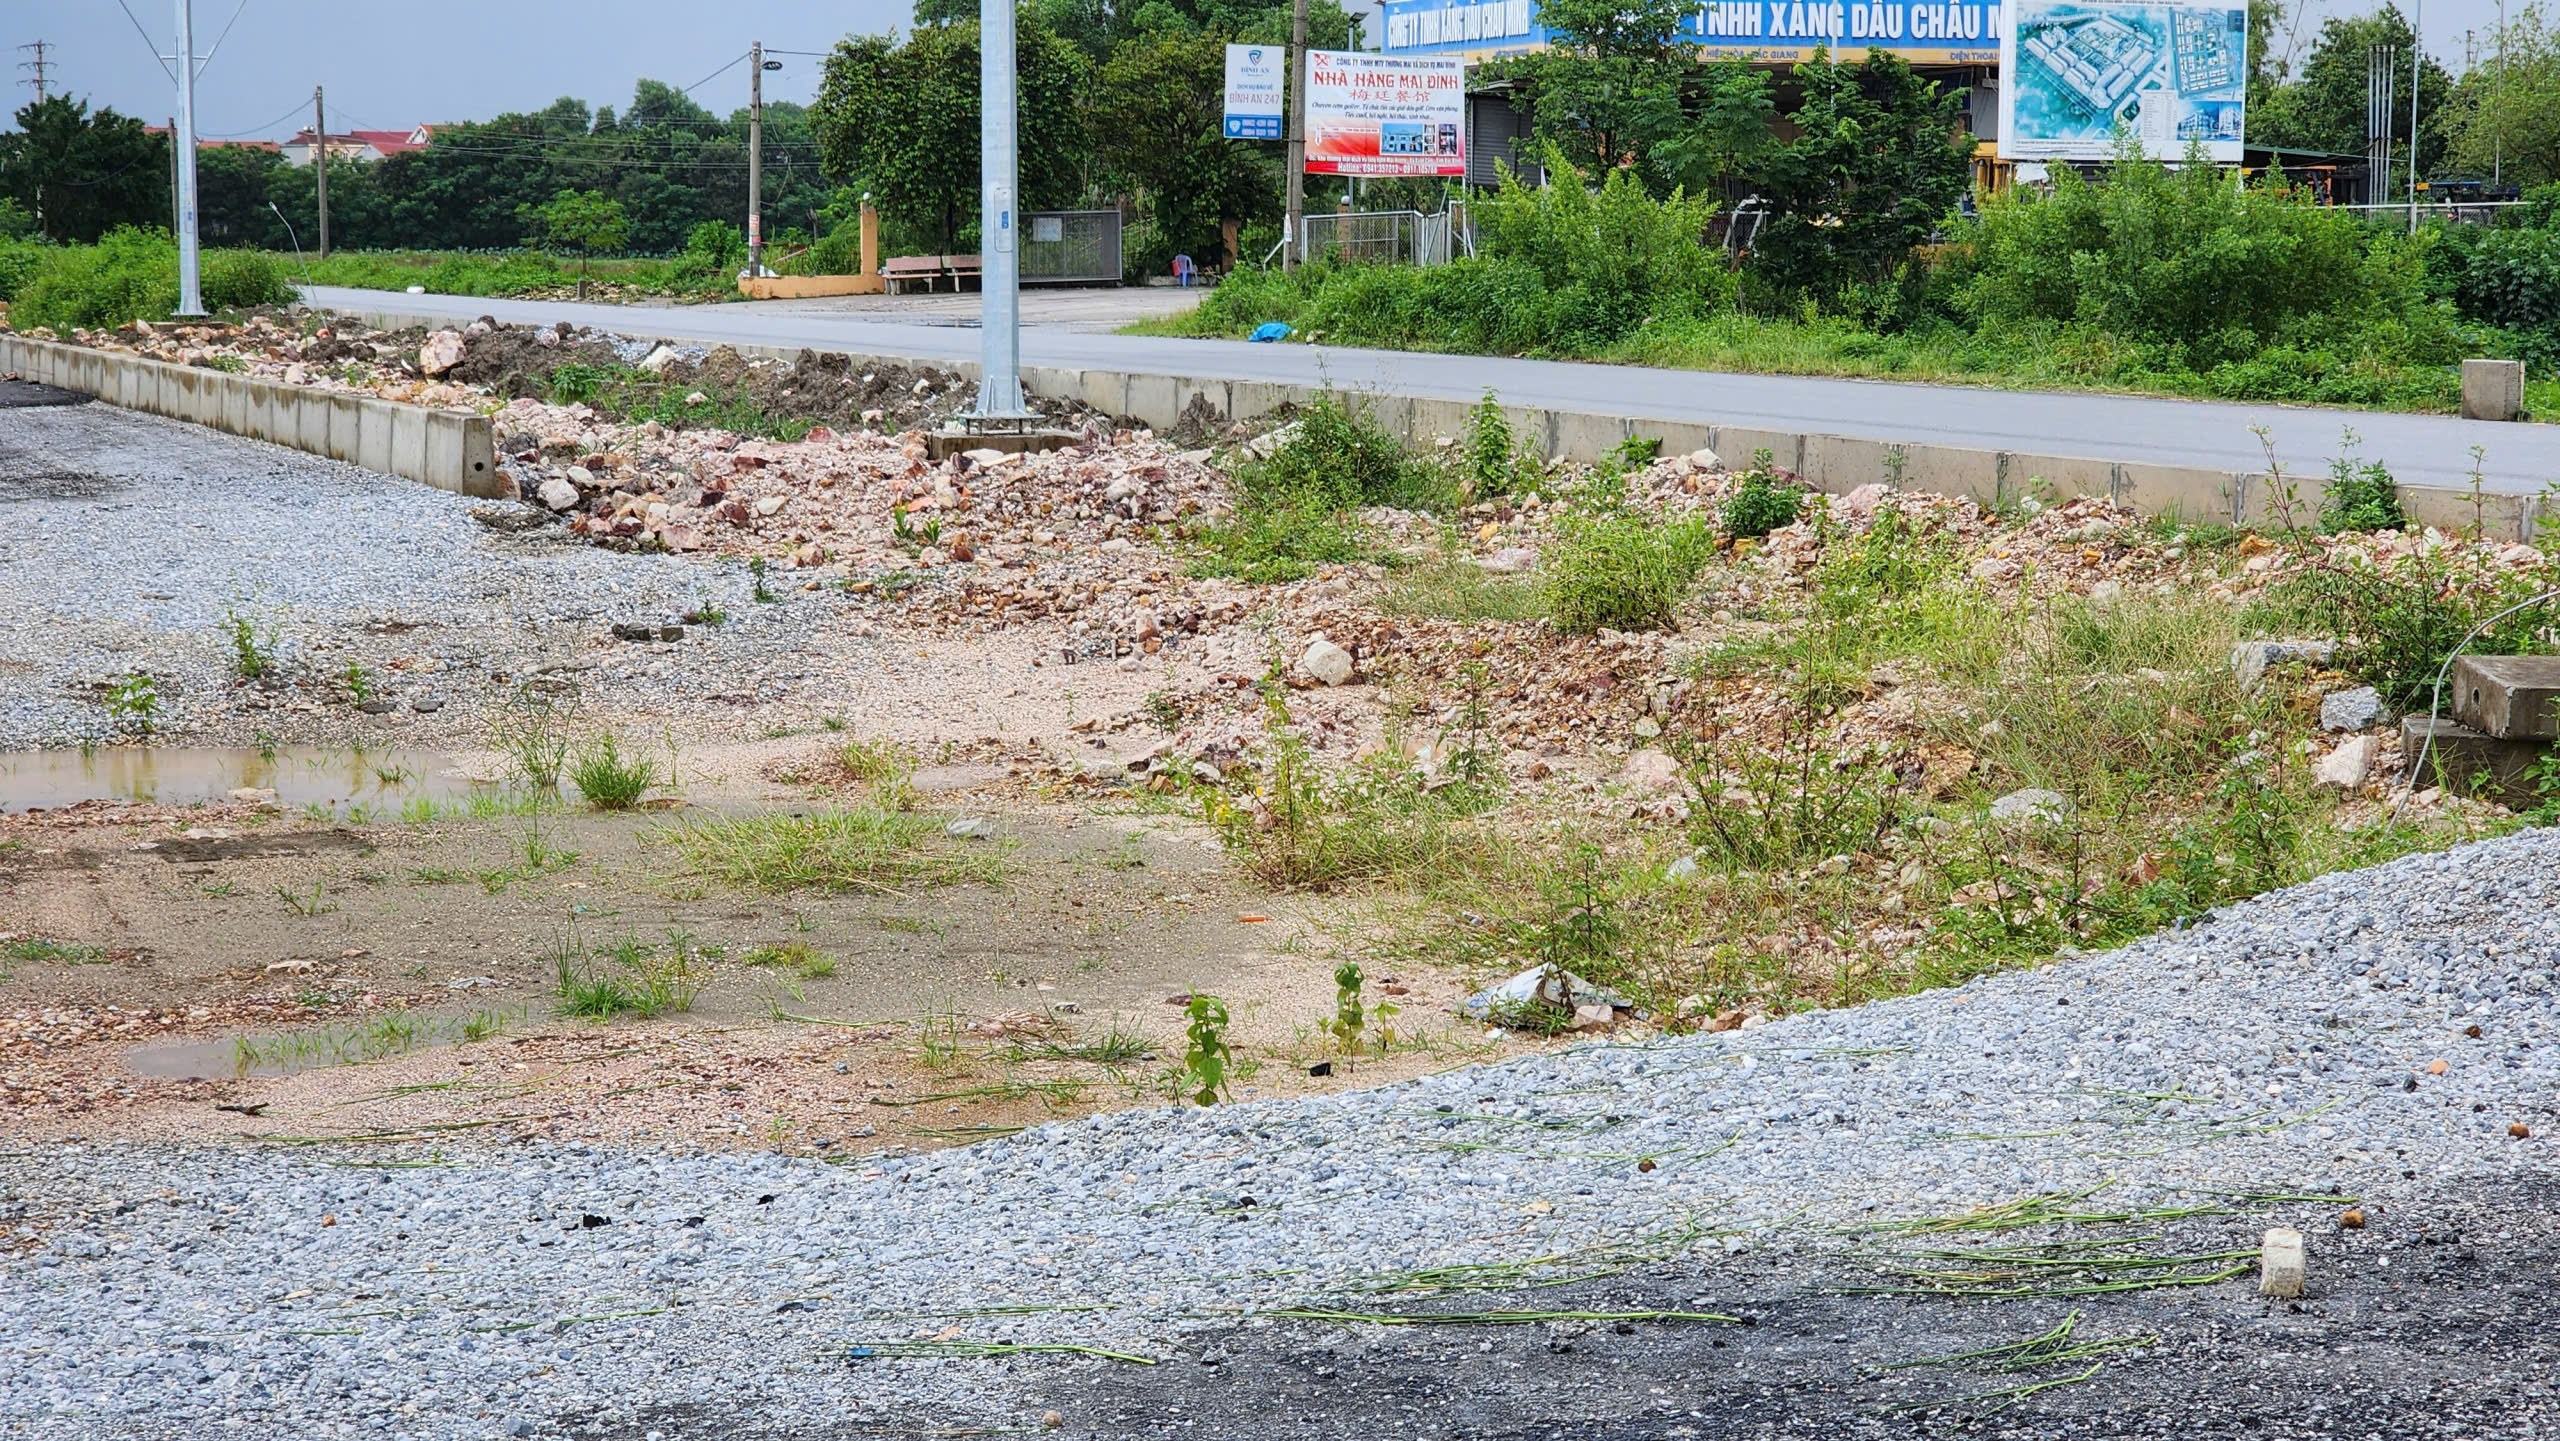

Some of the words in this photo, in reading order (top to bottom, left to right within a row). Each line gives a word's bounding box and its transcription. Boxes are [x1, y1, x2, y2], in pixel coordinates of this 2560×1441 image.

[1694, 1, 1761, 36] TNHH
[1770, 50, 1798, 59] GIANG
[1314, 69, 1348, 86] NHÀ
[1355, 70, 1395, 88] HÀNG
[1400, 75, 1423, 89] MAI
[1427, 72, 1459, 89] ĐÌNH
[1229, 91, 1248, 104] BÌNH
[1250, 93, 1263, 105] AN
[1264, 93, 1280, 105] 247
[1338, 162, 1362, 173] Hotline:
